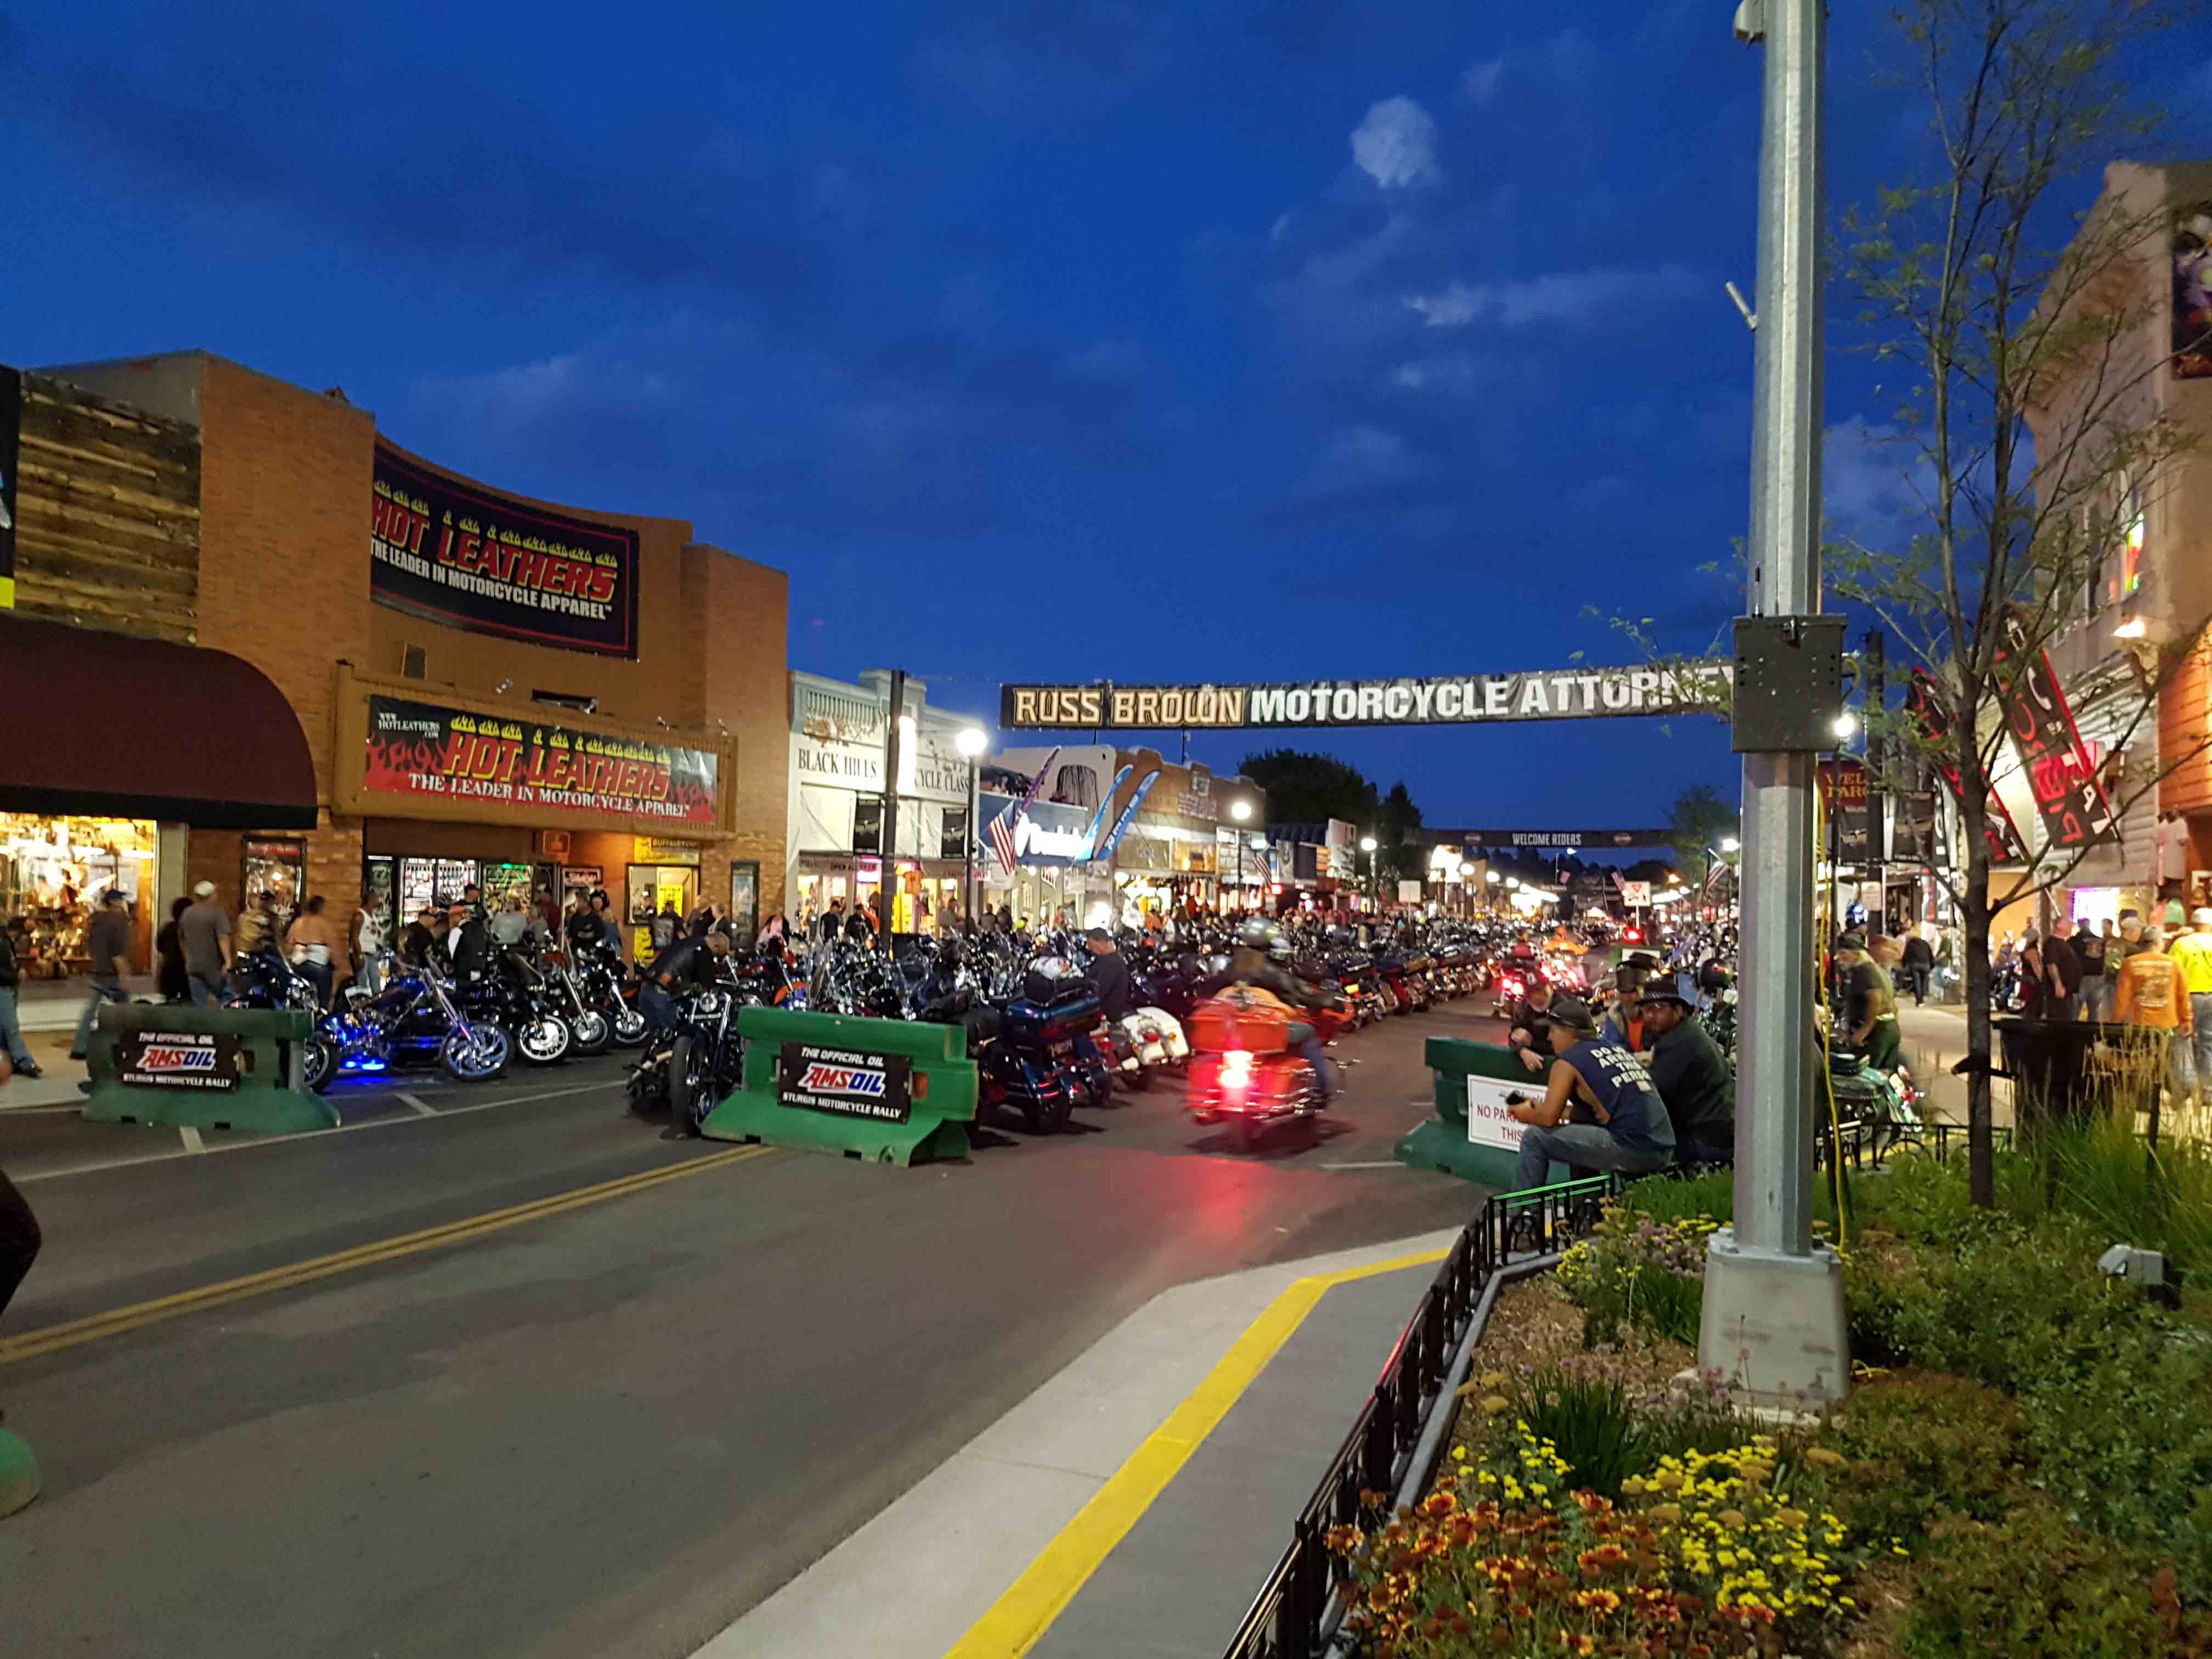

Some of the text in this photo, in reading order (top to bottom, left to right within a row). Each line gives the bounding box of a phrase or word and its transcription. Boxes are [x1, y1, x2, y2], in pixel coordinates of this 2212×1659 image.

[371, 495, 617, 602] HOT LEATHERS
[371, 538, 388, 562] THE
[390, 546, 430, 579] LEADER
[432, 563, 446, 584] IN
[449, 570, 538, 608] MOTORCYCLE
[1015, 690, 1102, 725] RUSS
[1111, 689, 1244, 725] BROWN
[1250, 684, 1509, 723] MOTORCYCLE
[443, 732, 672, 802] HOT LEATHERS
[799, 748, 877, 778] BLACK HILLS
[915, 768, 941, 790] CYCLE
[409, 772, 445, 793] THE
[450, 777, 512, 800] LEADER
[517, 786, 534, 801] IN
[540, 788, 633, 812] MOTORCYCLE
[1513, 833, 1582, 846] WELCOME RIDERS
[199, 1035, 214, 1045] OIL
[140, 1047, 216, 1068] AMSOIL
[801, 1046, 884, 1068] THE OFFICIAL OIL
[1590, 1046, 1612, 1058] DO
[205, 1077, 232, 1088] RALLY
[802, 1064, 885, 1094] AMSOIL
[782, 1091, 902, 1119] STURGIS MOTORCYCLE RALLY
[1477, 1104, 1491, 1118] NO
[1501, 1126, 1523, 1142] THIS
